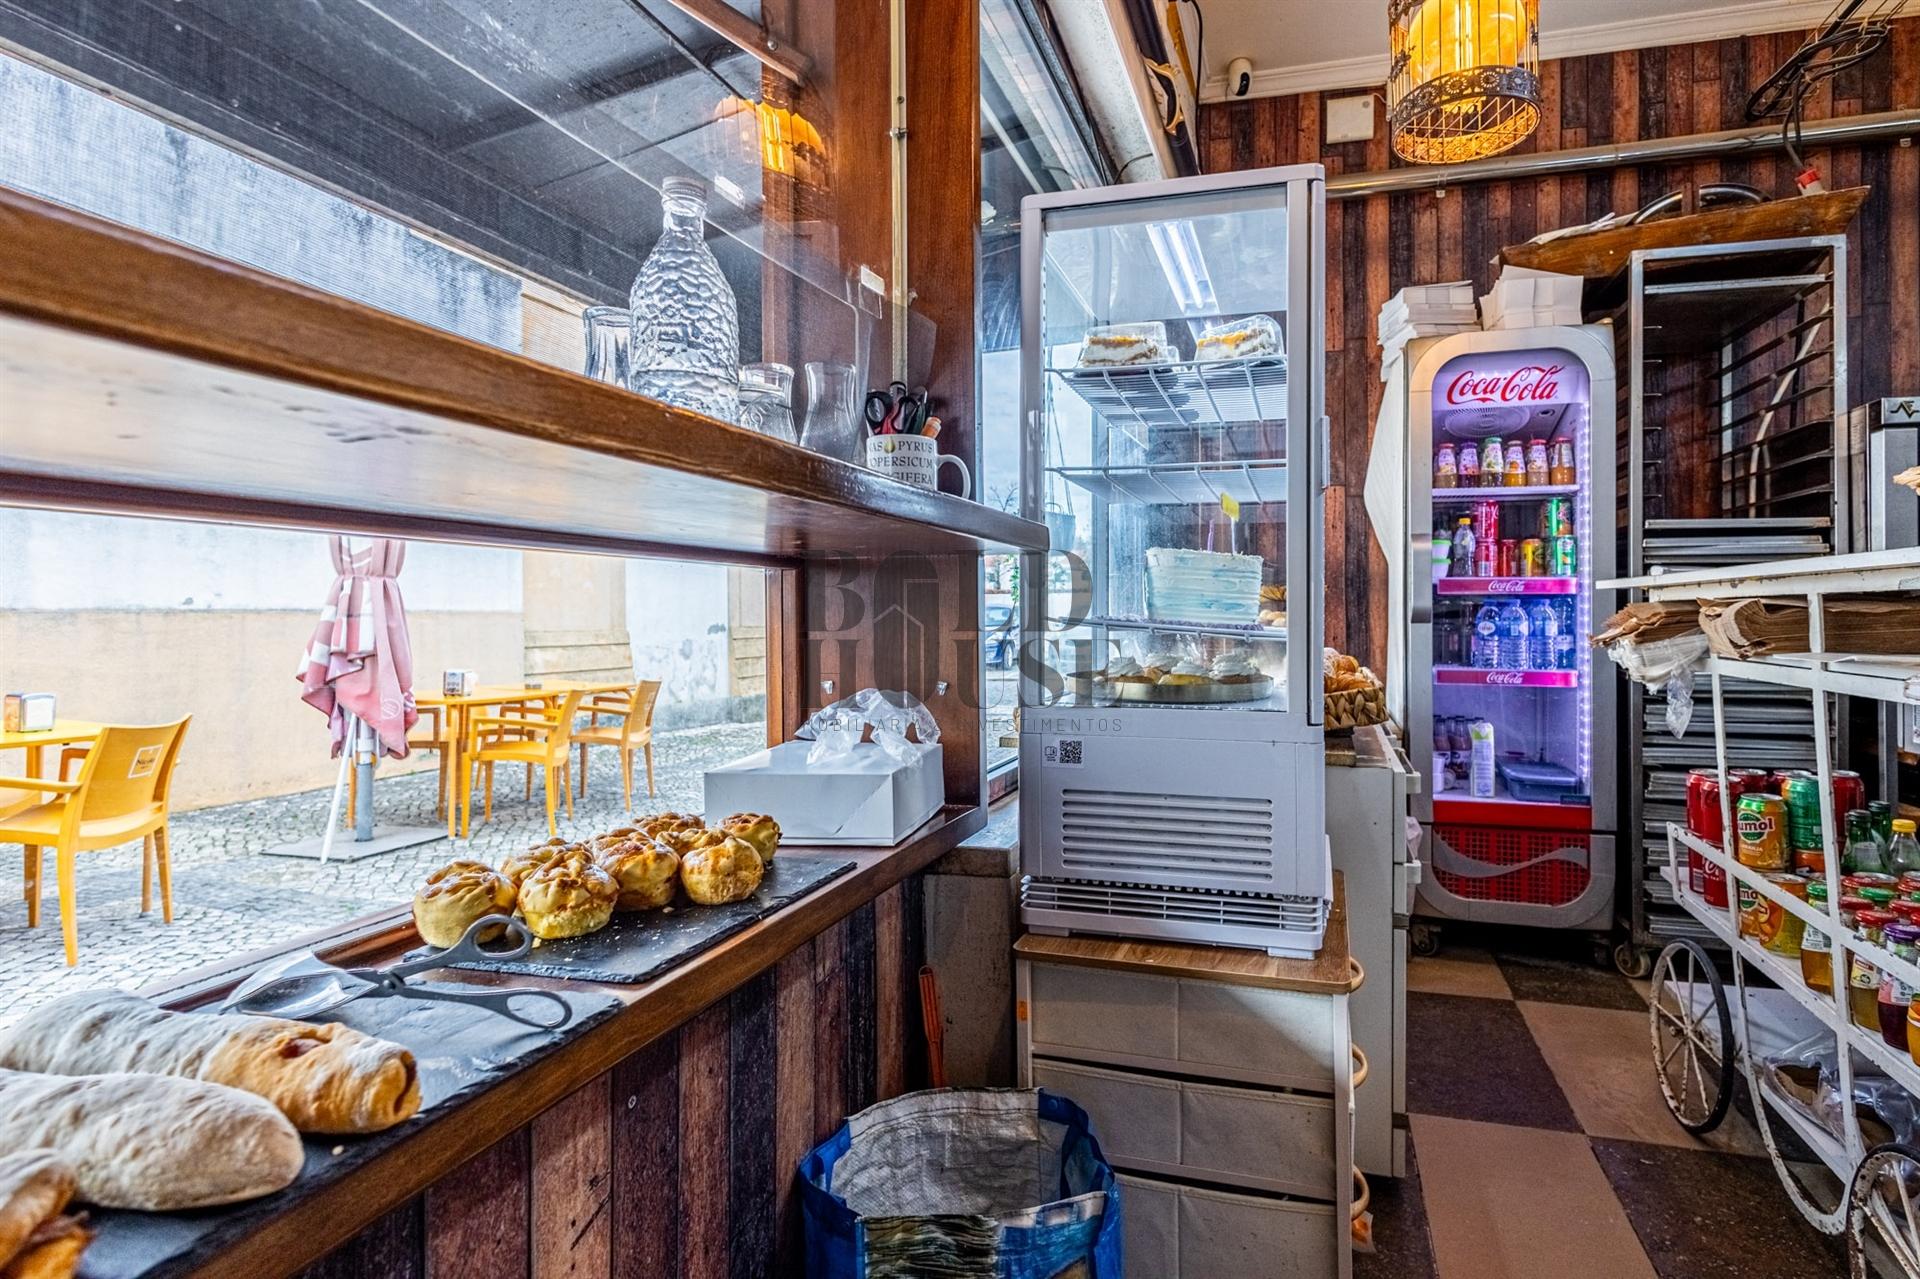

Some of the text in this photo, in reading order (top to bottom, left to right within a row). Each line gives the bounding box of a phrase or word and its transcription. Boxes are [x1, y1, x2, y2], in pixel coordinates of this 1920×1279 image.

[899, 441, 933, 454] PYRUS
[871, 457, 933, 469] OPERSICUM
[889, 473, 933, 485] GIFERA
